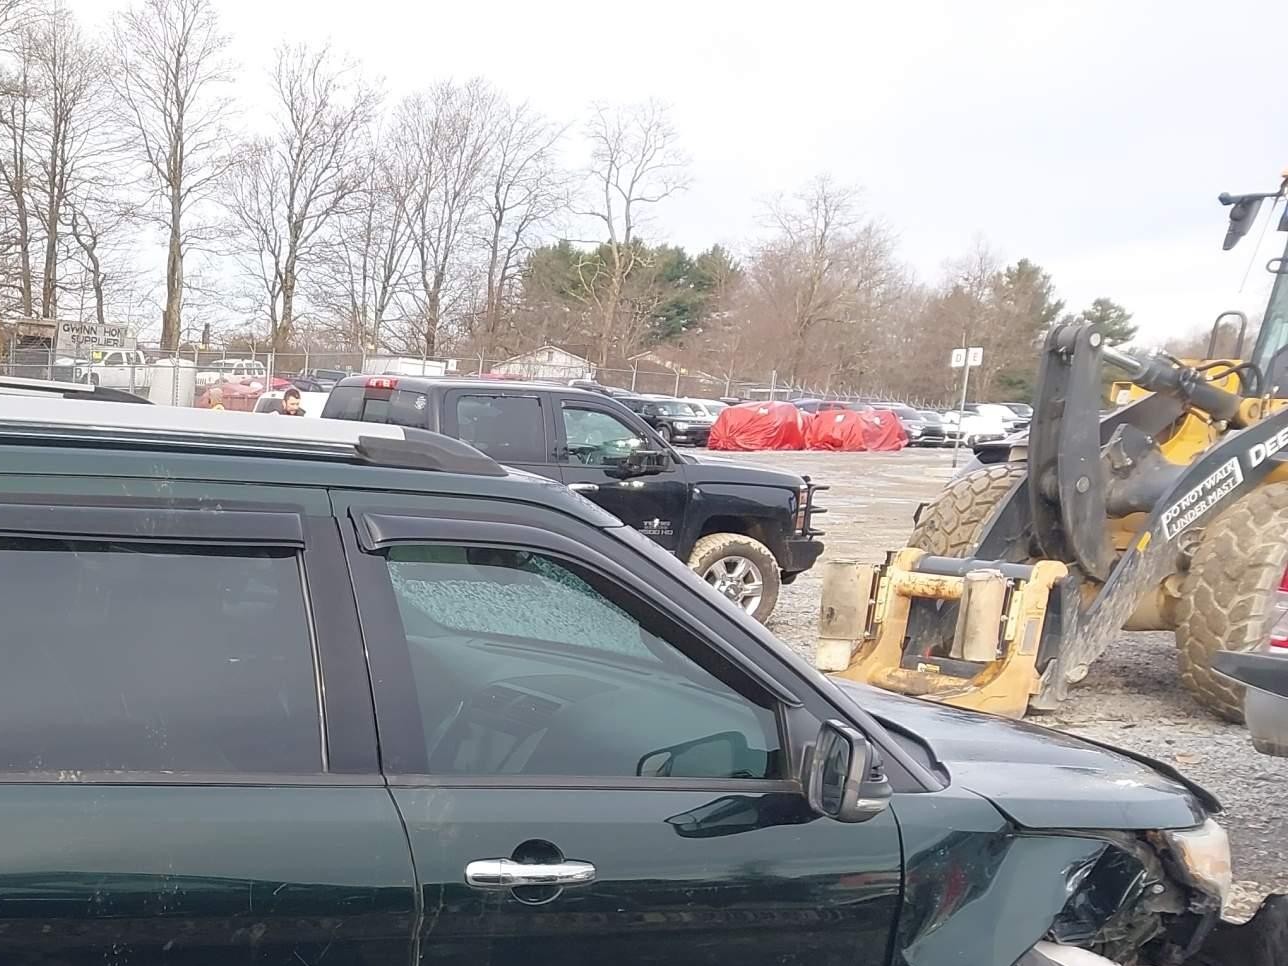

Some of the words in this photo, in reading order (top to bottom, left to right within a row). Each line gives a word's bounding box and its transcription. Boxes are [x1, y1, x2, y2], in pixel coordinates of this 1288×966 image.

[62, 323, 97, 335] GWINN
[1164, 504, 1180, 524] DO
[1180, 484, 1204, 510] NOT
[1205, 462, 1236, 490] WALK
[1171, 500, 1208, 533] UNDER
[1207, 476, 1237, 505] MAST
